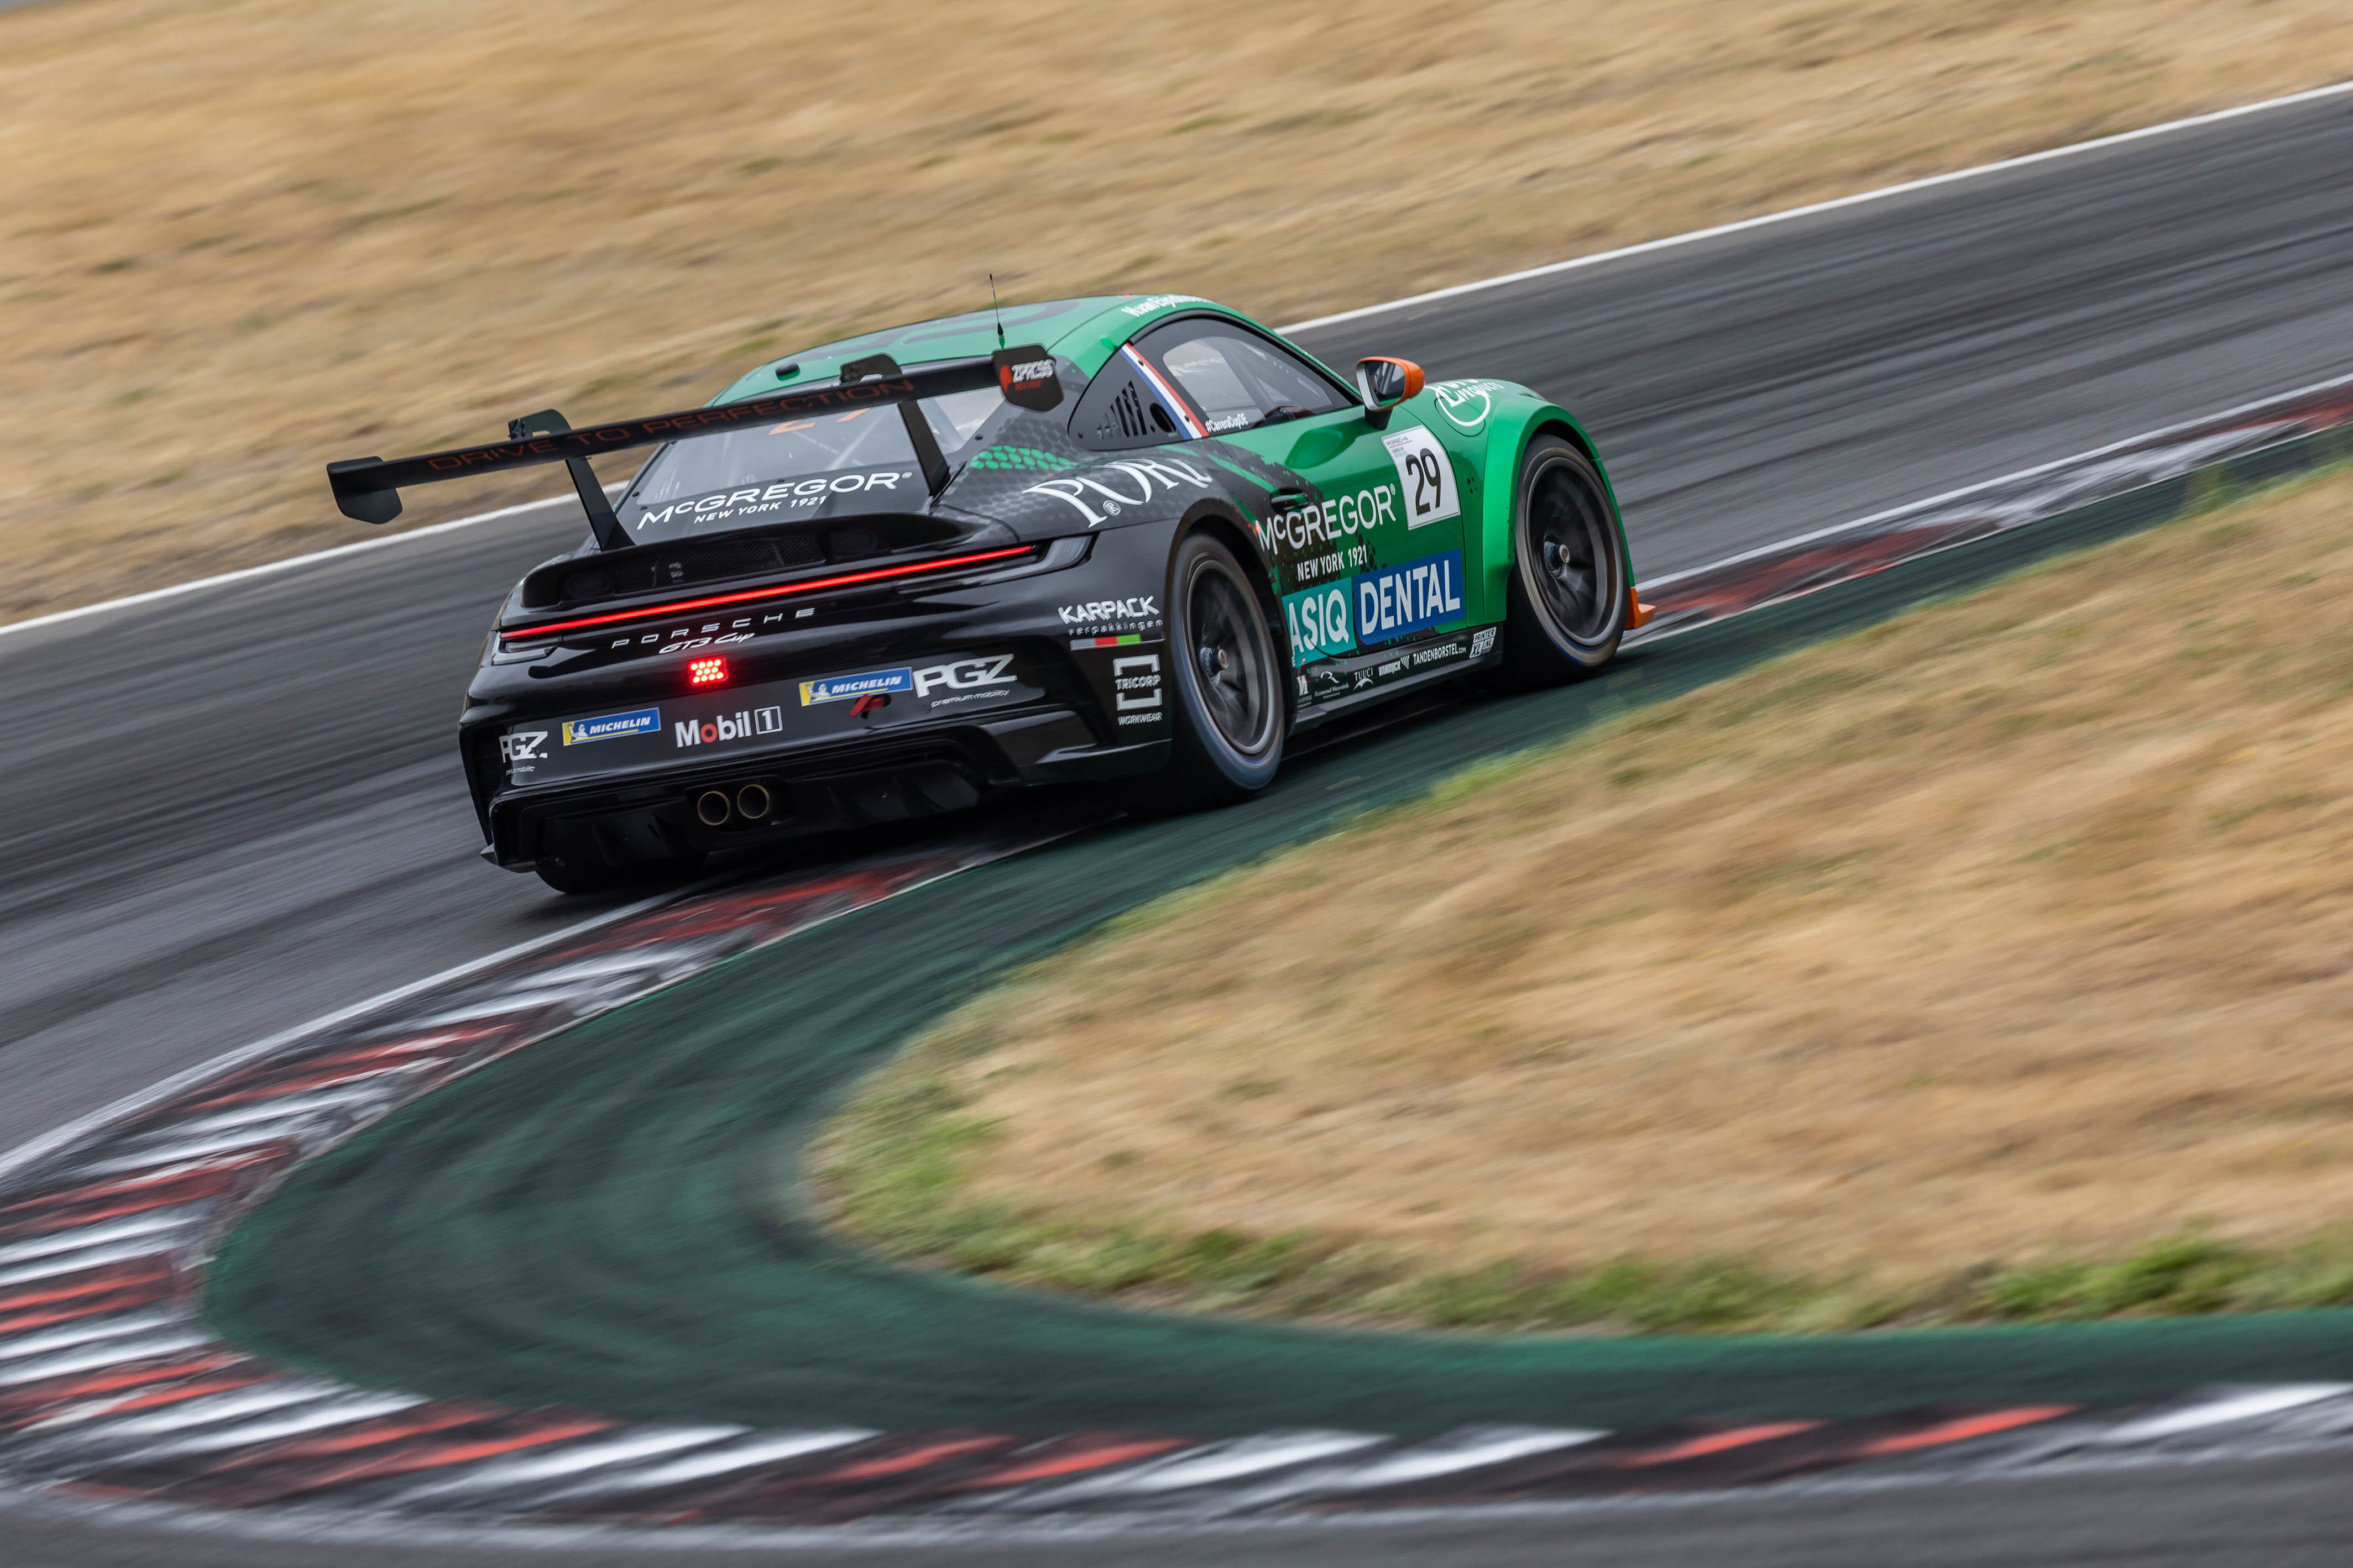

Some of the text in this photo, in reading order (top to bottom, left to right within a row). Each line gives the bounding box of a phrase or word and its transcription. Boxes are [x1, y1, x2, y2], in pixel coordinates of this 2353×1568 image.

[427, 440, 558, 470] DRIVE
[566, 428, 630, 445] TO
[642, 380, 915, 434] PERFECTION
[1205, 413, 1248, 433] #CarreraCupDE
[1405, 448, 1441, 516] 29
[694, 495, 827, 524] NEW YORK 1921
[1297, 544, 1367, 581] NEW YORK 1921
[1058, 595, 1160, 625] KARPACK
[1289, 559, 1460, 653] ASIQ DENTAL
[611, 607, 815, 649] PORSCHE
[1068, 620, 1163, 636] verpakkingen
[1474, 629, 1494, 642] PRINTER
[658, 632, 755, 654] GT3 Cup
[1471, 643, 1481, 657] XL
[832, 675, 902, 694] MICHELIN
[912, 653, 1017, 698] PGZ
[1115, 674, 1161, 690] TRICORP
[1354, 667, 1373, 681] TUUCI
[589, 717, 651, 734] MICHELIN
[674, 710, 773, 748] Mobil 1
[1118, 712, 1162, 725] WORKWEAR
[499, 731, 548, 763] PGZ
